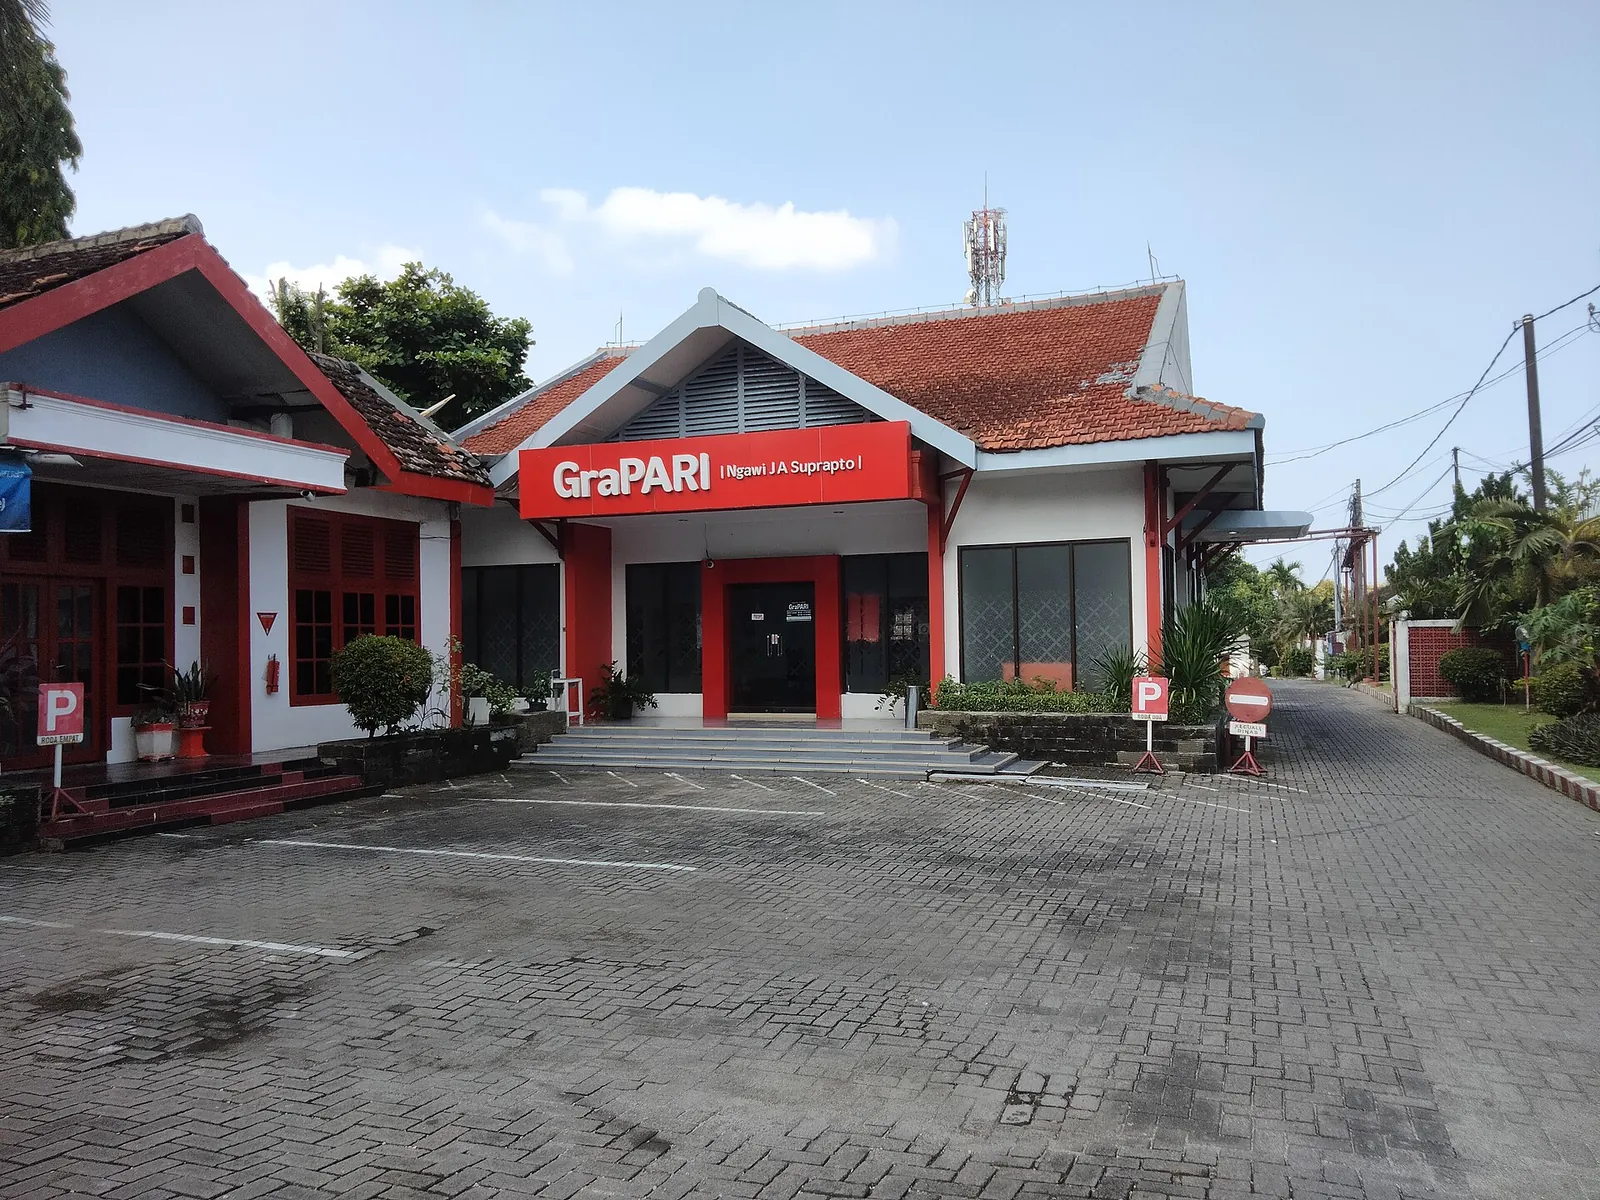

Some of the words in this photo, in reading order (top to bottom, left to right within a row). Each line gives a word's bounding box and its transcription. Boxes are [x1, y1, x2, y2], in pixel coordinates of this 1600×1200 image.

[553, 452, 711, 498] GraPARI
[726, 463, 767, 480] Ngawi
[790, 458, 855, 476] Suprapto
[47, 690, 77, 731] P
[1138, 682, 1162, 711] P
[60, 735, 80, 743] EMPAT
